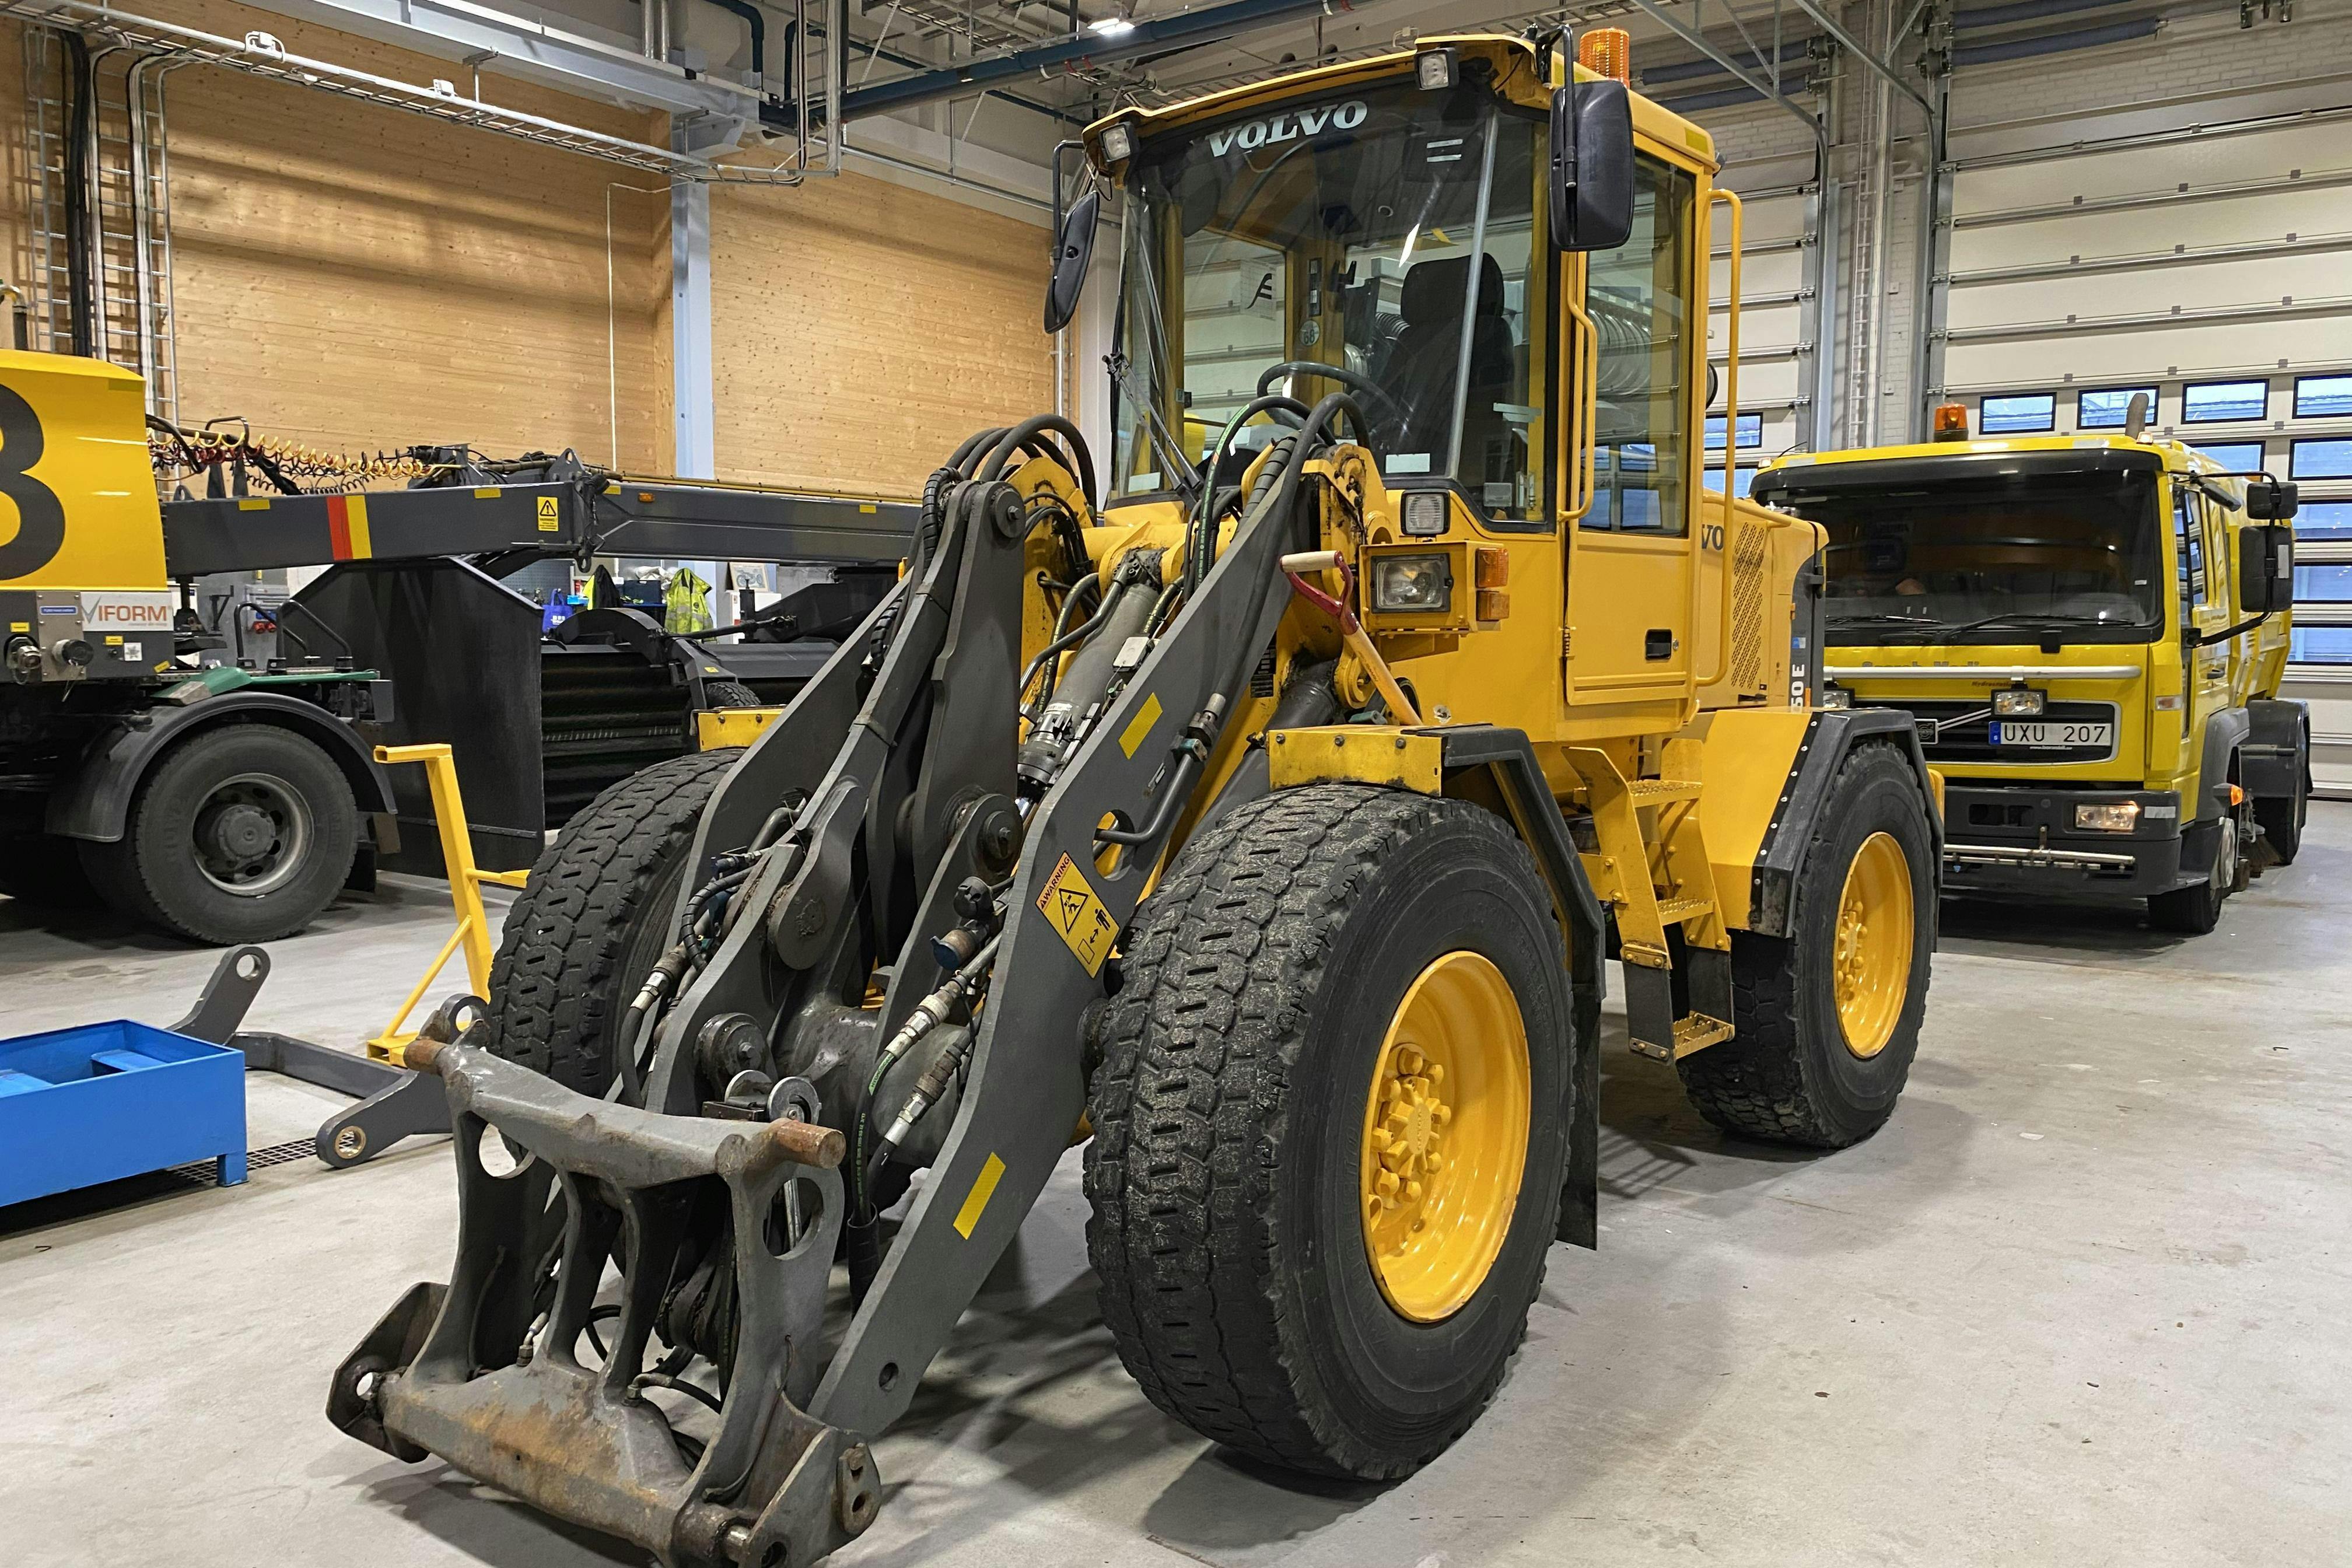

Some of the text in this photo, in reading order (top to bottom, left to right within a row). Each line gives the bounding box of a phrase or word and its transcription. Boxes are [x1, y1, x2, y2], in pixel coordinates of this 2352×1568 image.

[1205, 101, 1367, 157] VOLVO
[2004, 724, 2045, 742] UXU
[2063, 726, 2106, 743] 207
[1042, 857, 1070, 902] WARNING
